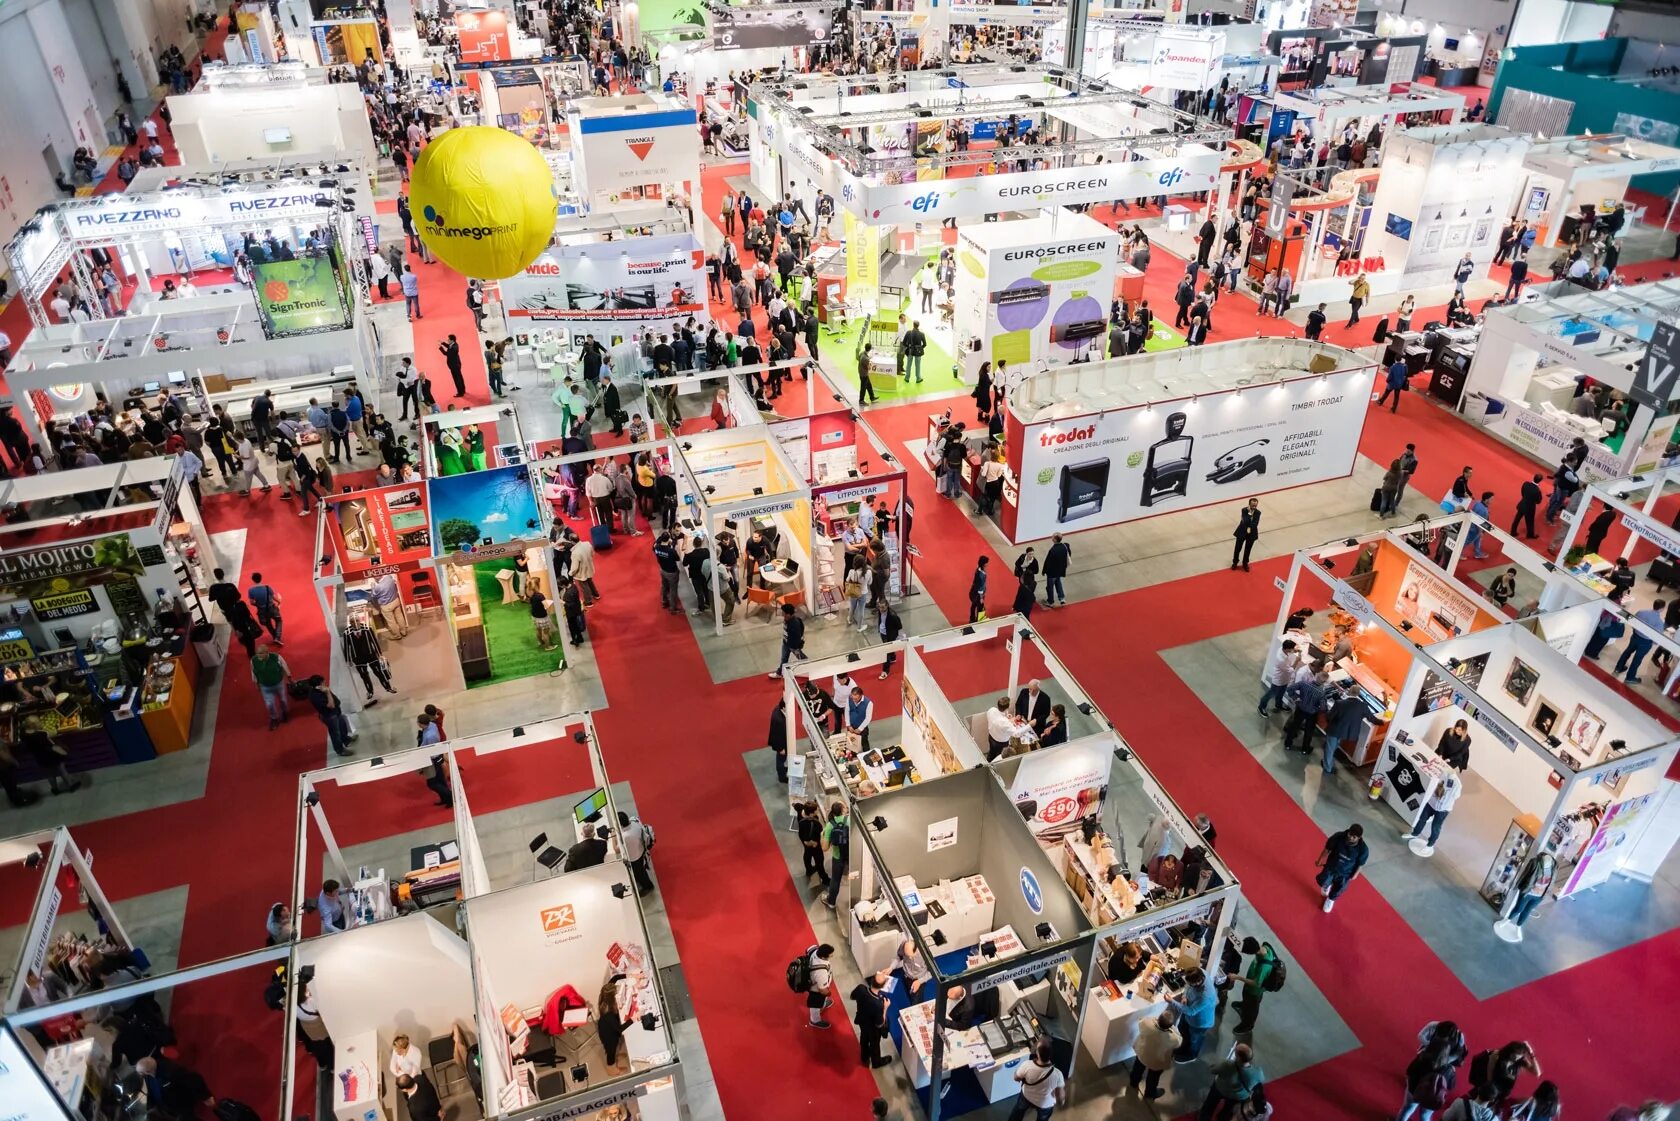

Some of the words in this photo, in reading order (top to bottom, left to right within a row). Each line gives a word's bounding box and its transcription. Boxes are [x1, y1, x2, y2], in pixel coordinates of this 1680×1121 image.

[1166, 53, 1207, 65] spandex
[625, 136, 656, 144] TRIANGLE
[788, 143, 824, 176] EUROSCREEN
[1159, 167, 1184, 187] efi
[842, 184, 854, 202] efi
[998, 178, 1108, 198] EUROSCREEN
[230, 191, 327, 214] AVEZZANO
[912, 191, 942, 213] efi
[77, 207, 181, 226] AVEZZANO
[1270, 204, 1286, 232] U
[1004, 241, 1106, 261] EUROSCREEN
[1666, 331, 1676, 347] 1
[1646, 355, 1676, 394] V
[1291, 400, 1316, 411] TIMBRI
[1317, 395, 1344, 407] TRODAT
[1518, 409, 1550, 432] XEROX
[1040, 424, 1097, 447] trodat
[1284, 428, 1324, 442] AFFIDABILI.
[1054, 443, 1086, 454] CREAZIONE
[1086, 441, 1101, 449] DEGLI
[1102, 436, 1130, 446] ORIGINALI
[1282, 439, 1318, 452] ELEGANTI.
[1520, 420, 1544, 440] ESCLUSIVA
[1547, 434, 1557, 445] PER
[1600, 463, 1618, 478] ITALIA
[1279, 448, 1317, 462] ORIGINALI.
[837, 486, 878, 500] LITPOLSTAR
[731, 504, 780, 520] DYNAMICSOFT
[780, 502, 793, 512] SRL
[1623, 518, 1668, 547] TECNOTRONICA
[20, 543, 97, 569] MOJITO
[362, 564, 400, 578] LIKEIDEAS
[34, 600, 45, 610] LA
[45, 592, 91, 607] BODEGUITA
[46, 609, 63, 618] DEL
[63, 604, 88, 616] MEDIO
[1152, 793, 1171, 815] FENIX
[1169, 813, 1187, 838] S.R.L.
[1556, 816, 1570, 833] Z20
[1138, 914, 1191, 935] PIPPONLINE
[976, 980, 992, 991] ATS
[992, 955, 1068, 986] coloredigitale.com
[620, 1090, 637, 1100] PK
